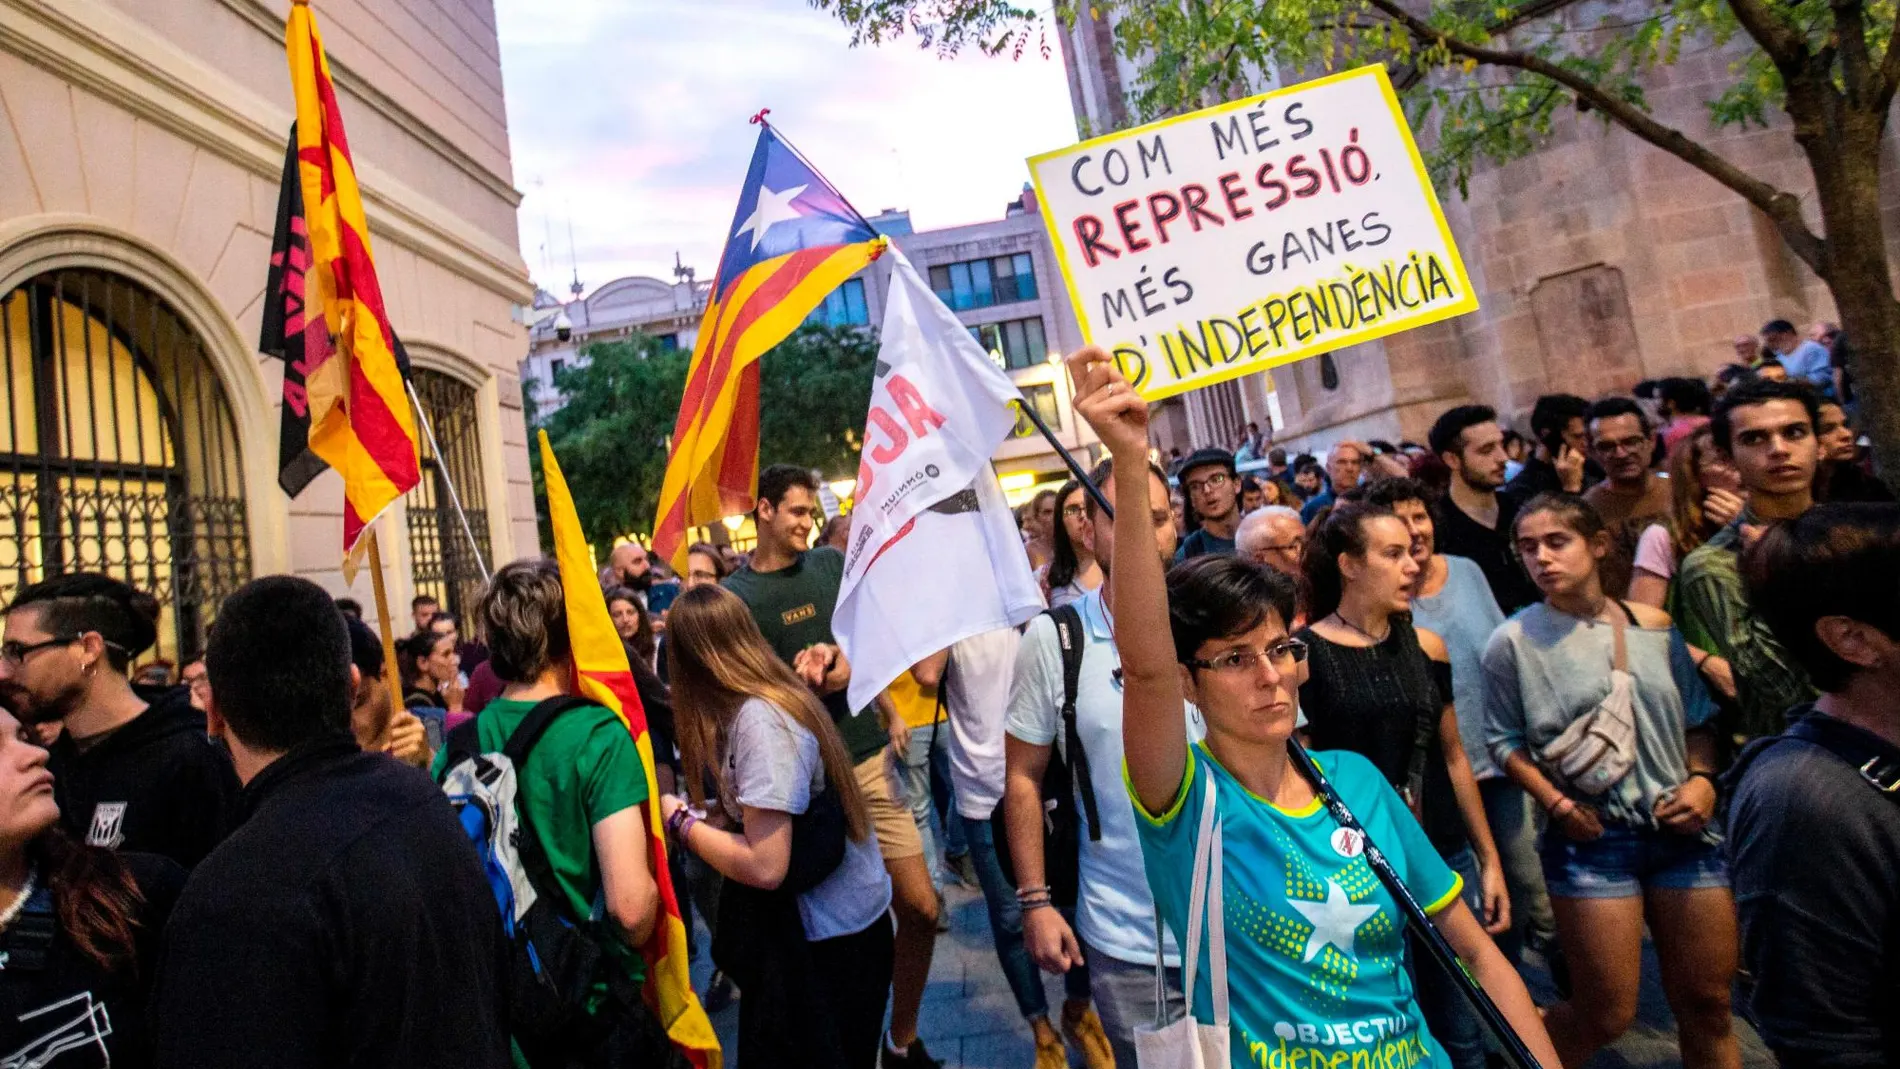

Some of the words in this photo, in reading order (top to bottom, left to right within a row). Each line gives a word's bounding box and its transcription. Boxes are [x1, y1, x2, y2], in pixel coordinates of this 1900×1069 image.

[1071, 134, 1172, 197] COM
[1210, 100, 1314, 161] MÉS
[1101, 265, 1194, 329] MÉS
[1246, 212, 1392, 277] GANES
